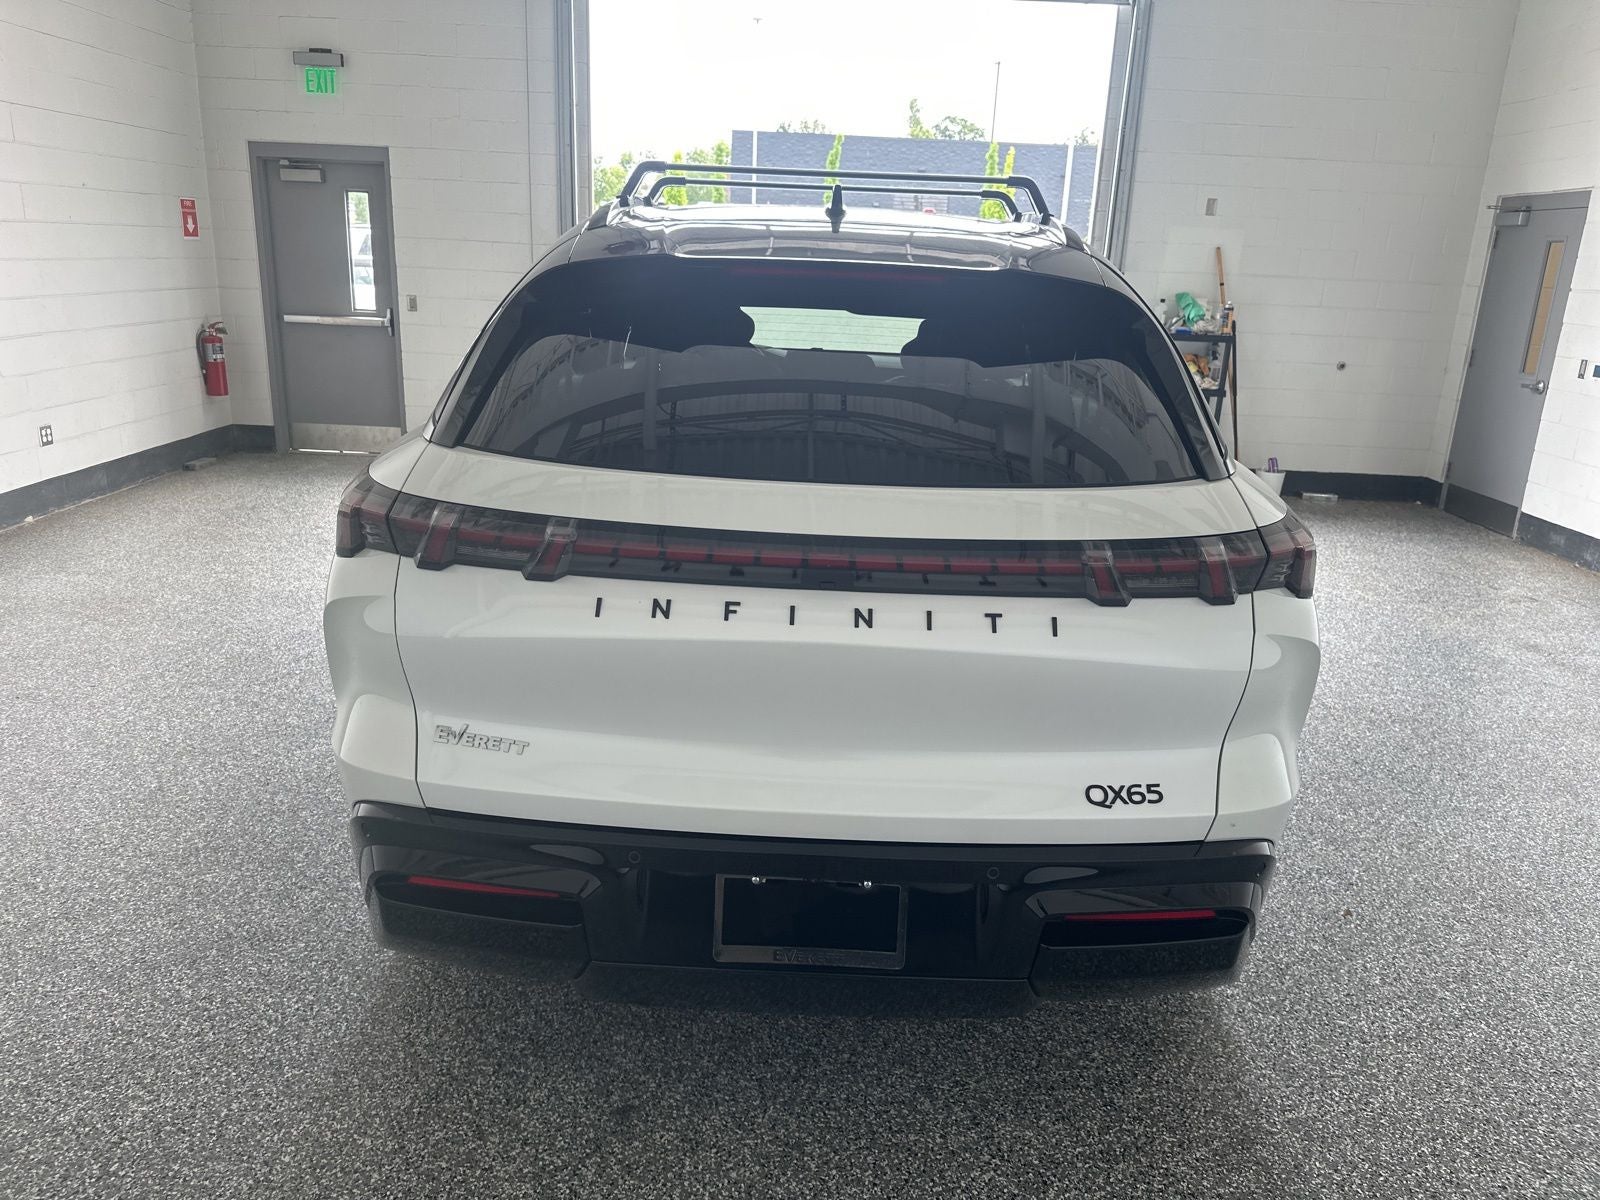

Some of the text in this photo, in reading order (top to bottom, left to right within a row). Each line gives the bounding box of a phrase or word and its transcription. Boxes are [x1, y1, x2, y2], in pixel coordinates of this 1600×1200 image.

[305, 68, 336, 94] EXIT
[594, 596, 1060, 638] INFINITI
[433, 723, 530, 756] EVERETT
[1084, 783, 1164, 809] QX65
